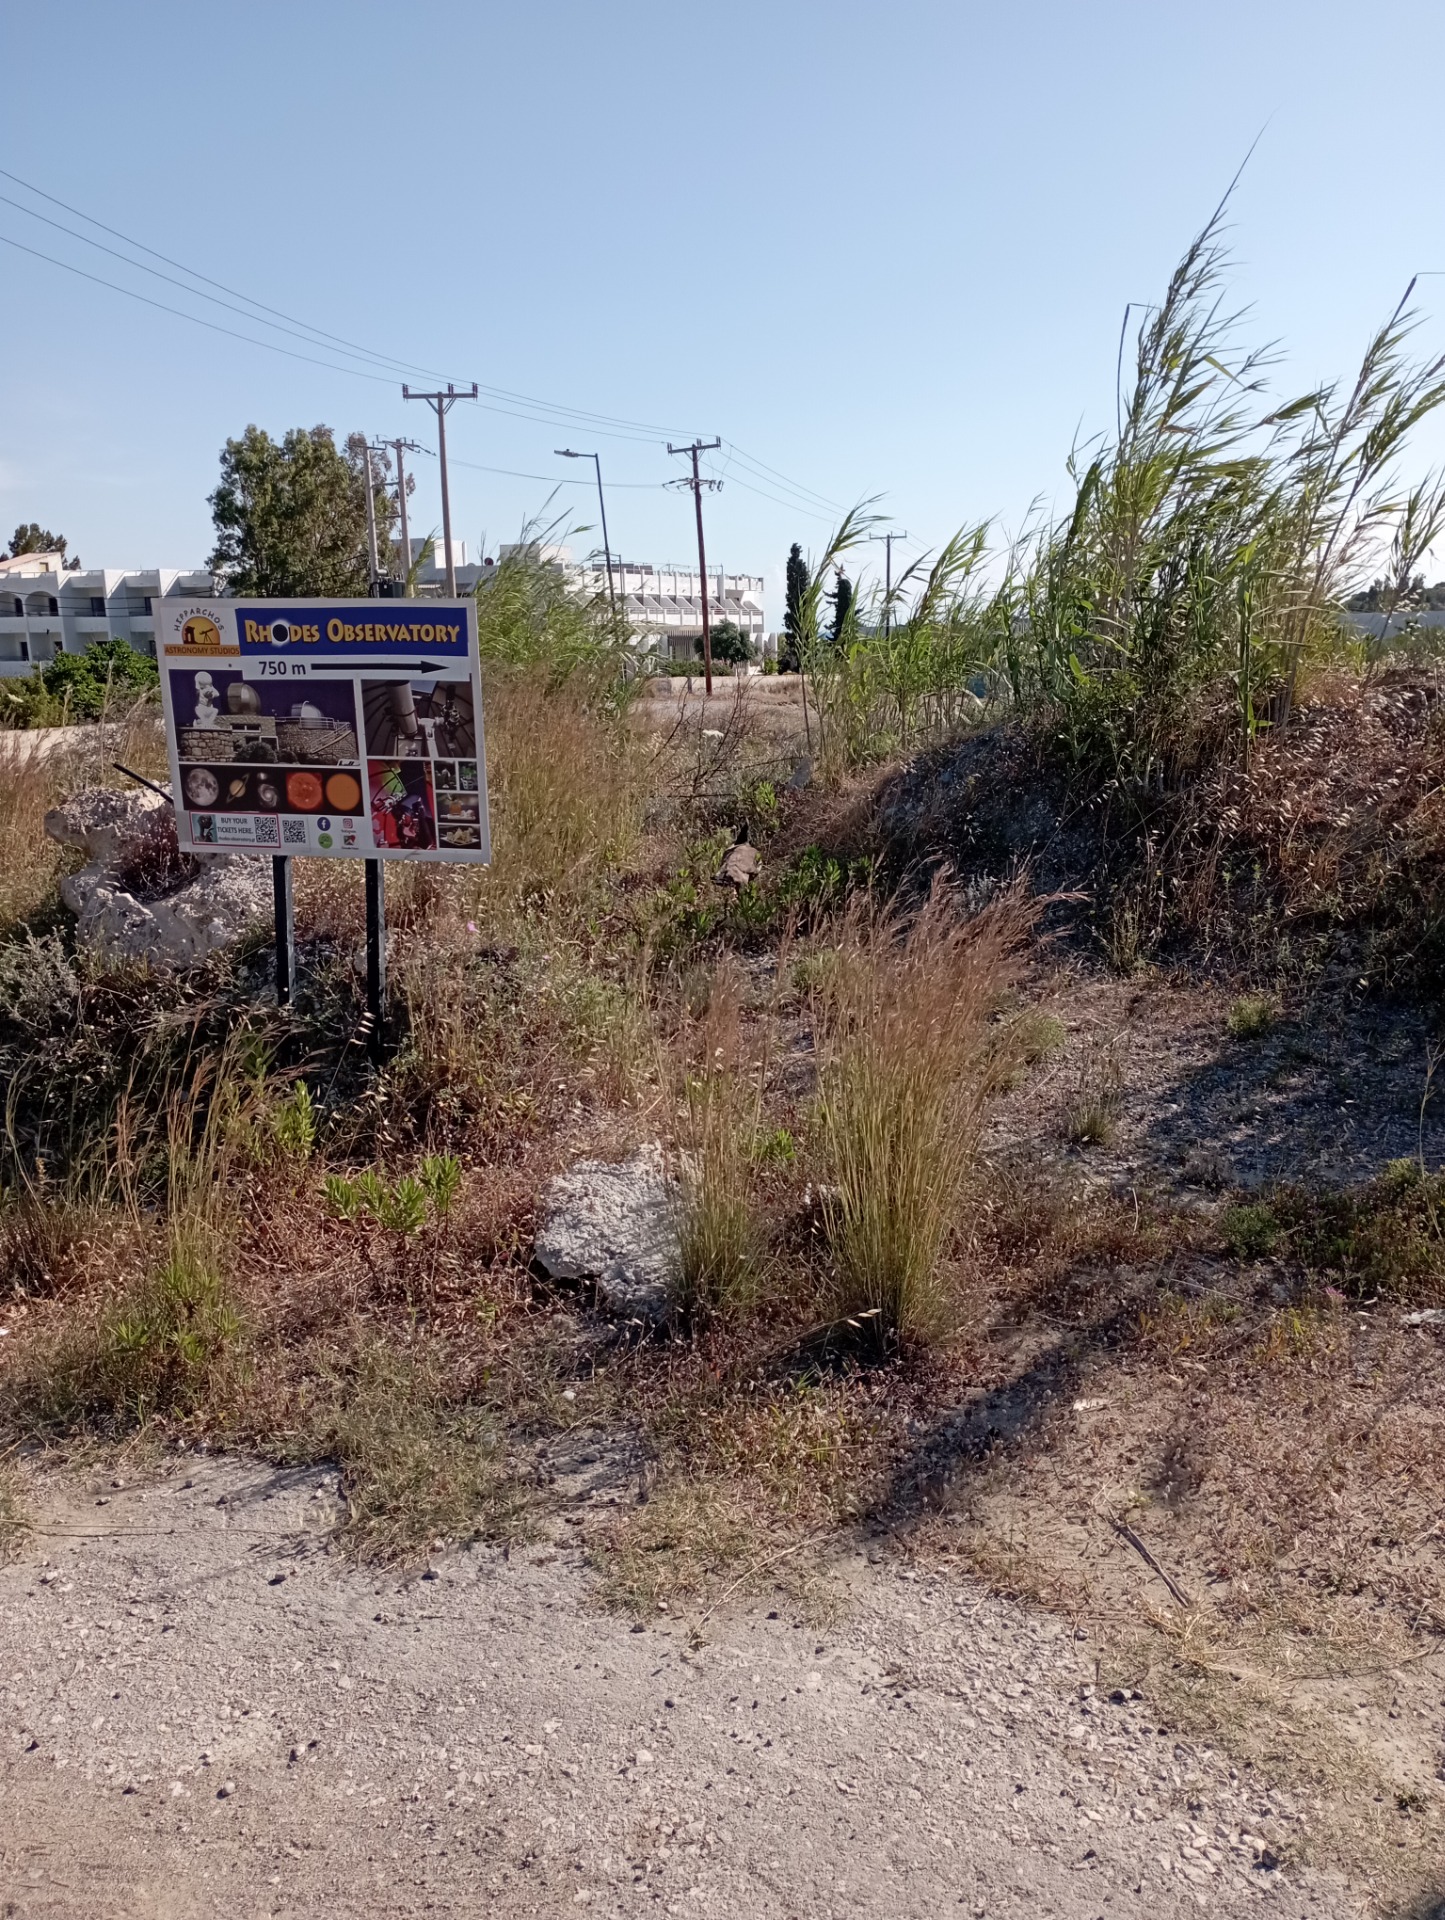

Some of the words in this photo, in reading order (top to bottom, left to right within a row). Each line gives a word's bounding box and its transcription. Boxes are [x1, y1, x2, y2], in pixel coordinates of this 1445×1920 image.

[174, 607, 225, 632] HIPPARCHOS
[326, 618, 460, 643] OBSERVATORY
[165, 646, 208, 654] ASTRONOMY
[210, 647, 240, 655] STUDIOS
[258, 661, 287, 676] 750
[291, 663, 307, 676] m
[233, 817, 248, 825] YOUR
[217, 826, 237, 834] TICKETS
[238, 827, 254, 835] HERE.
